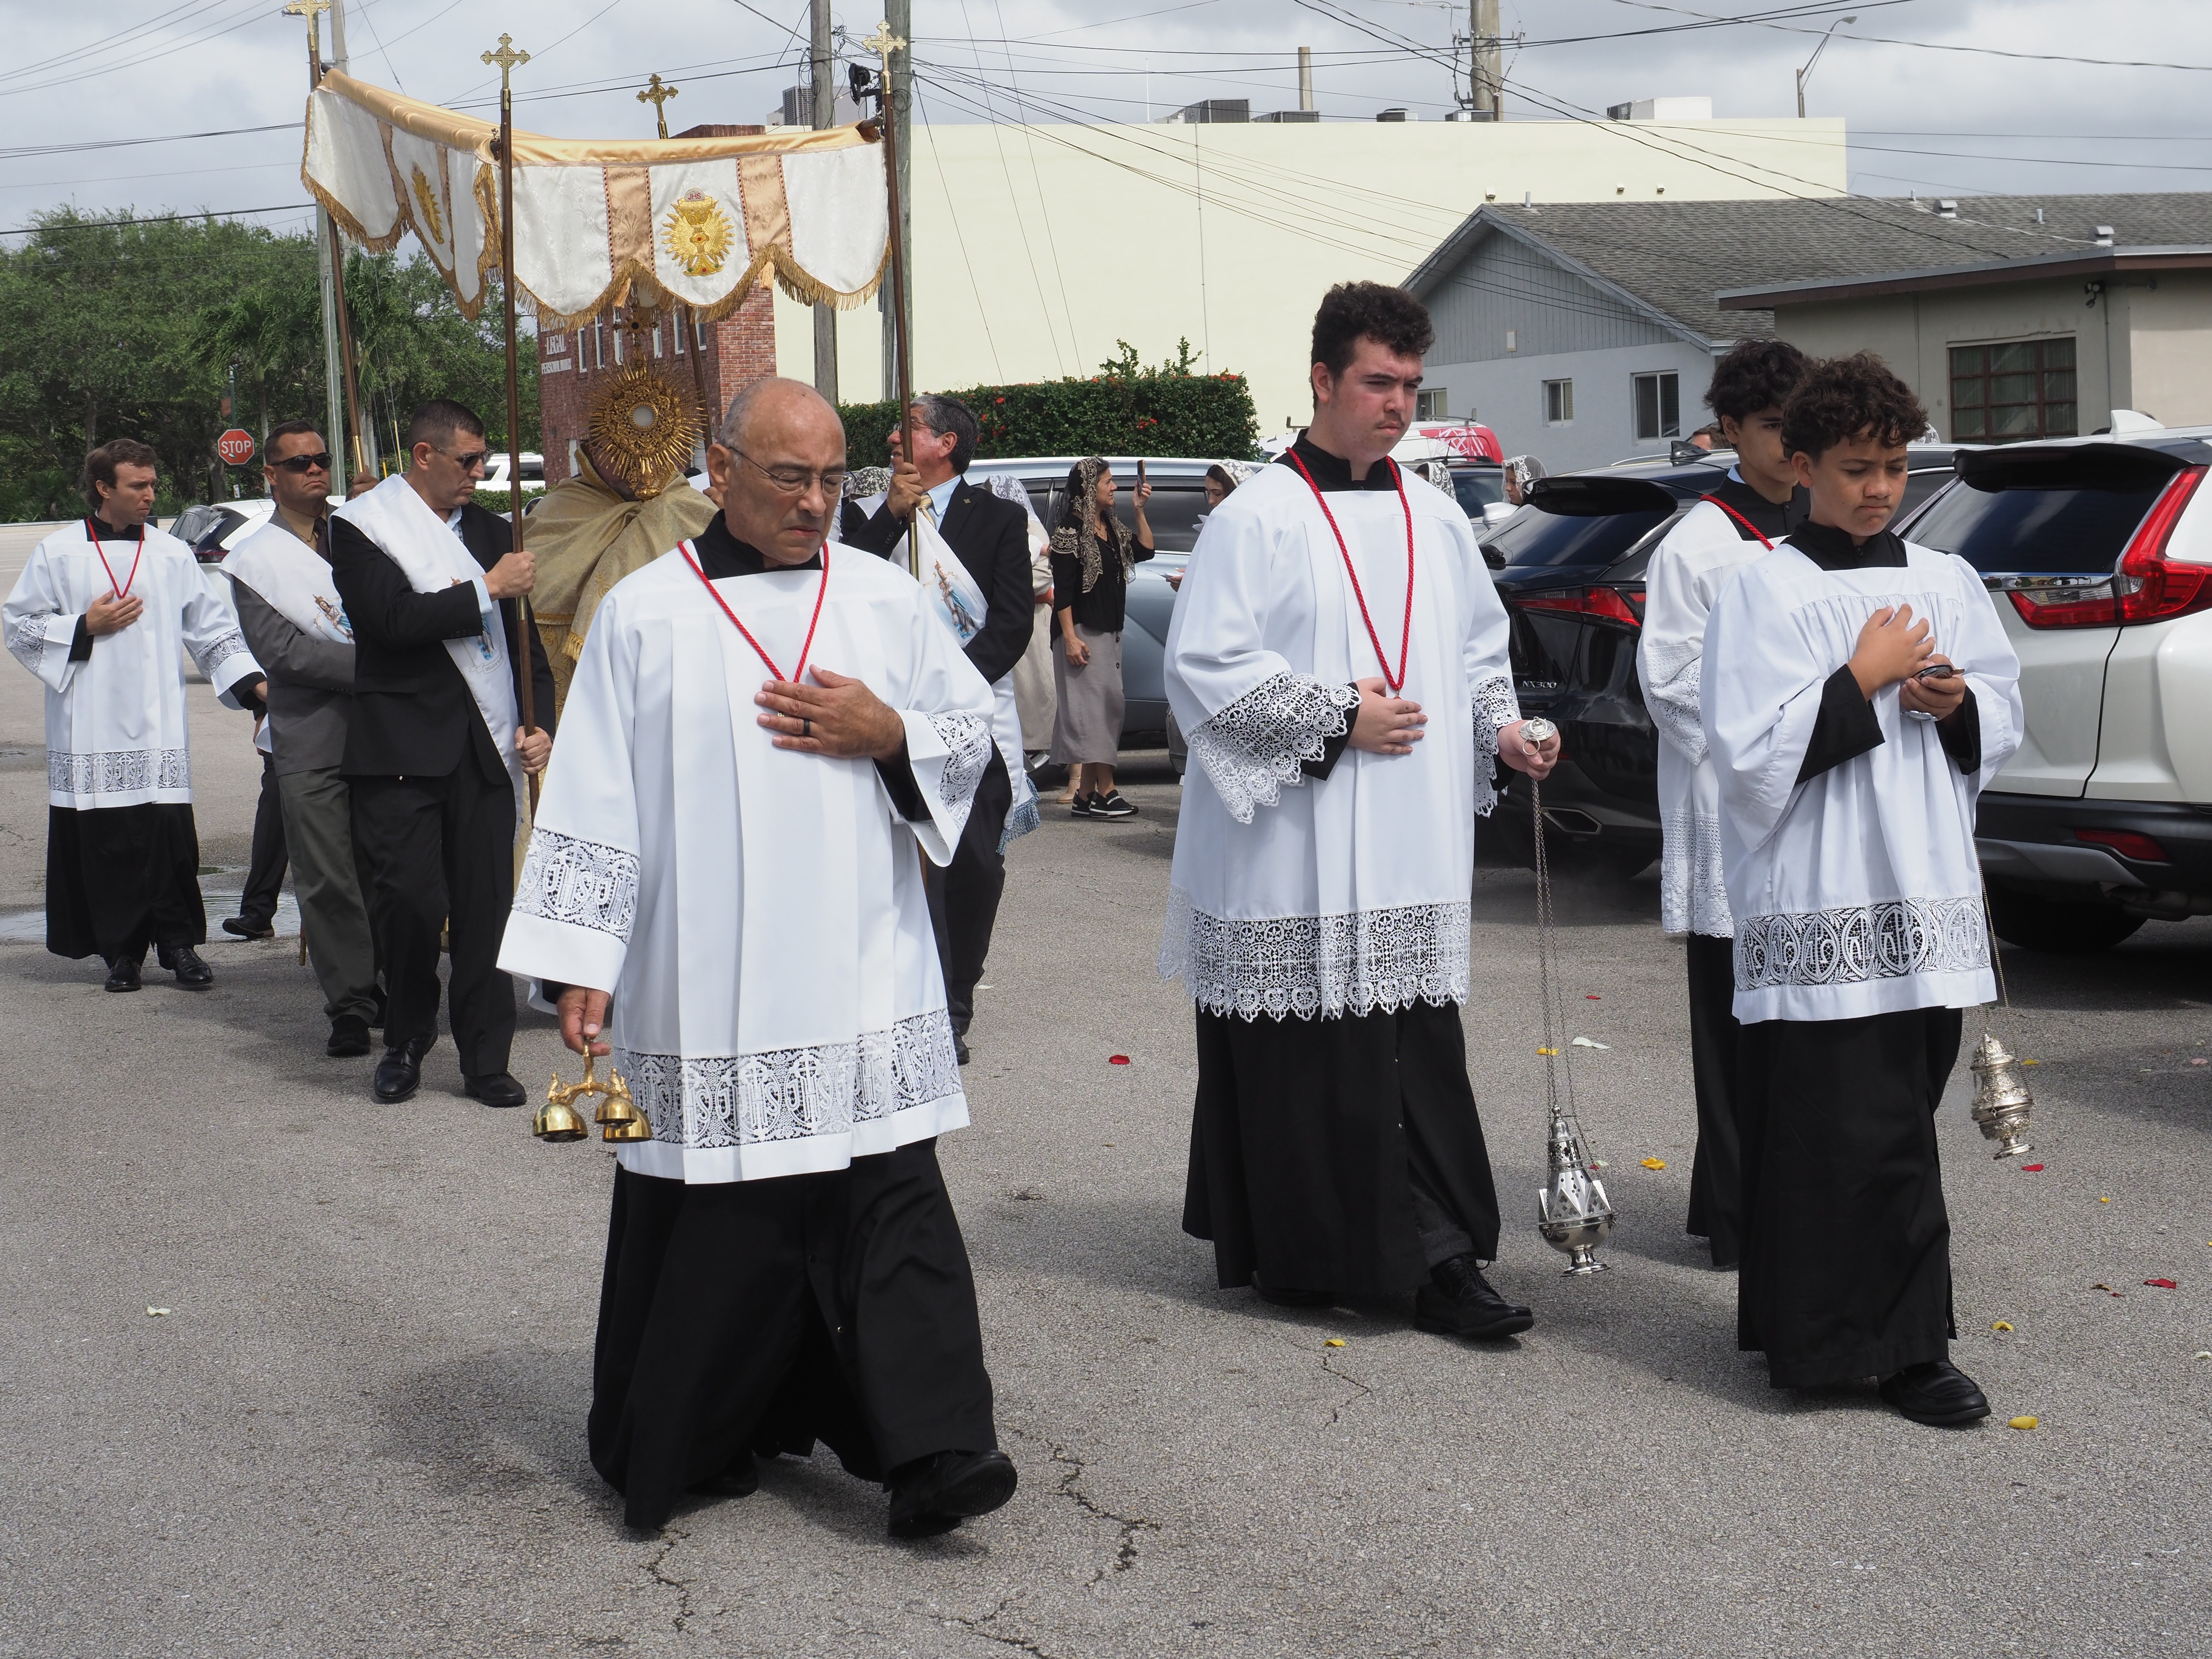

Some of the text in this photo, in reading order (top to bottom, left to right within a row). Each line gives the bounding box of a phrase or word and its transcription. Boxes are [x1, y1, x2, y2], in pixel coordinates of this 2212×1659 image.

[546, 334, 567, 355] LEGAL
[221, 440, 251, 454] STOP
[1522, 681, 1557, 689] NX300
